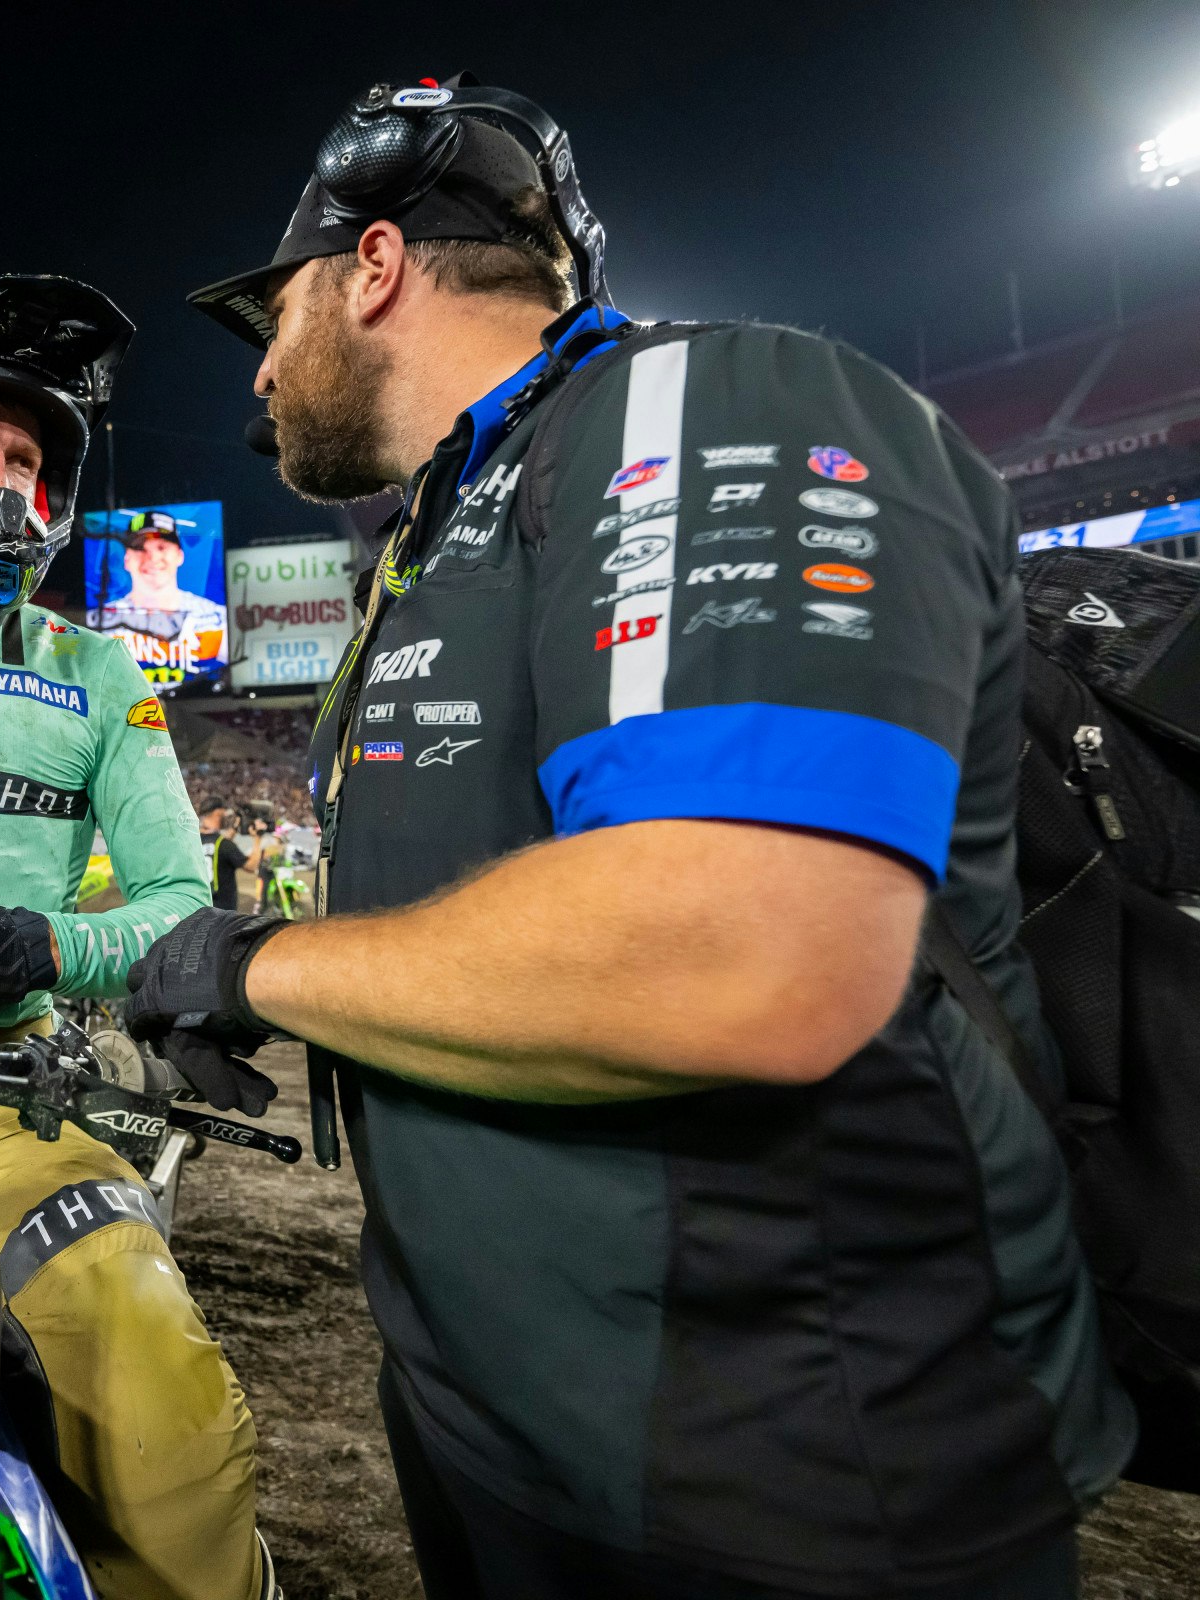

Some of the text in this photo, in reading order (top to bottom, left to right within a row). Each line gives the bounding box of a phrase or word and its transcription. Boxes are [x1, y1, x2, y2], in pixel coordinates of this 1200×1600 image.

[288, 598, 346, 626] BUCS
[266, 641, 319, 660] BUD
[257, 658, 330, 683] LIGHT
[416, 705, 476, 722] PROTAPER
[86, 1109, 167, 1138] ARC
[188, 1119, 256, 1145] ARC
